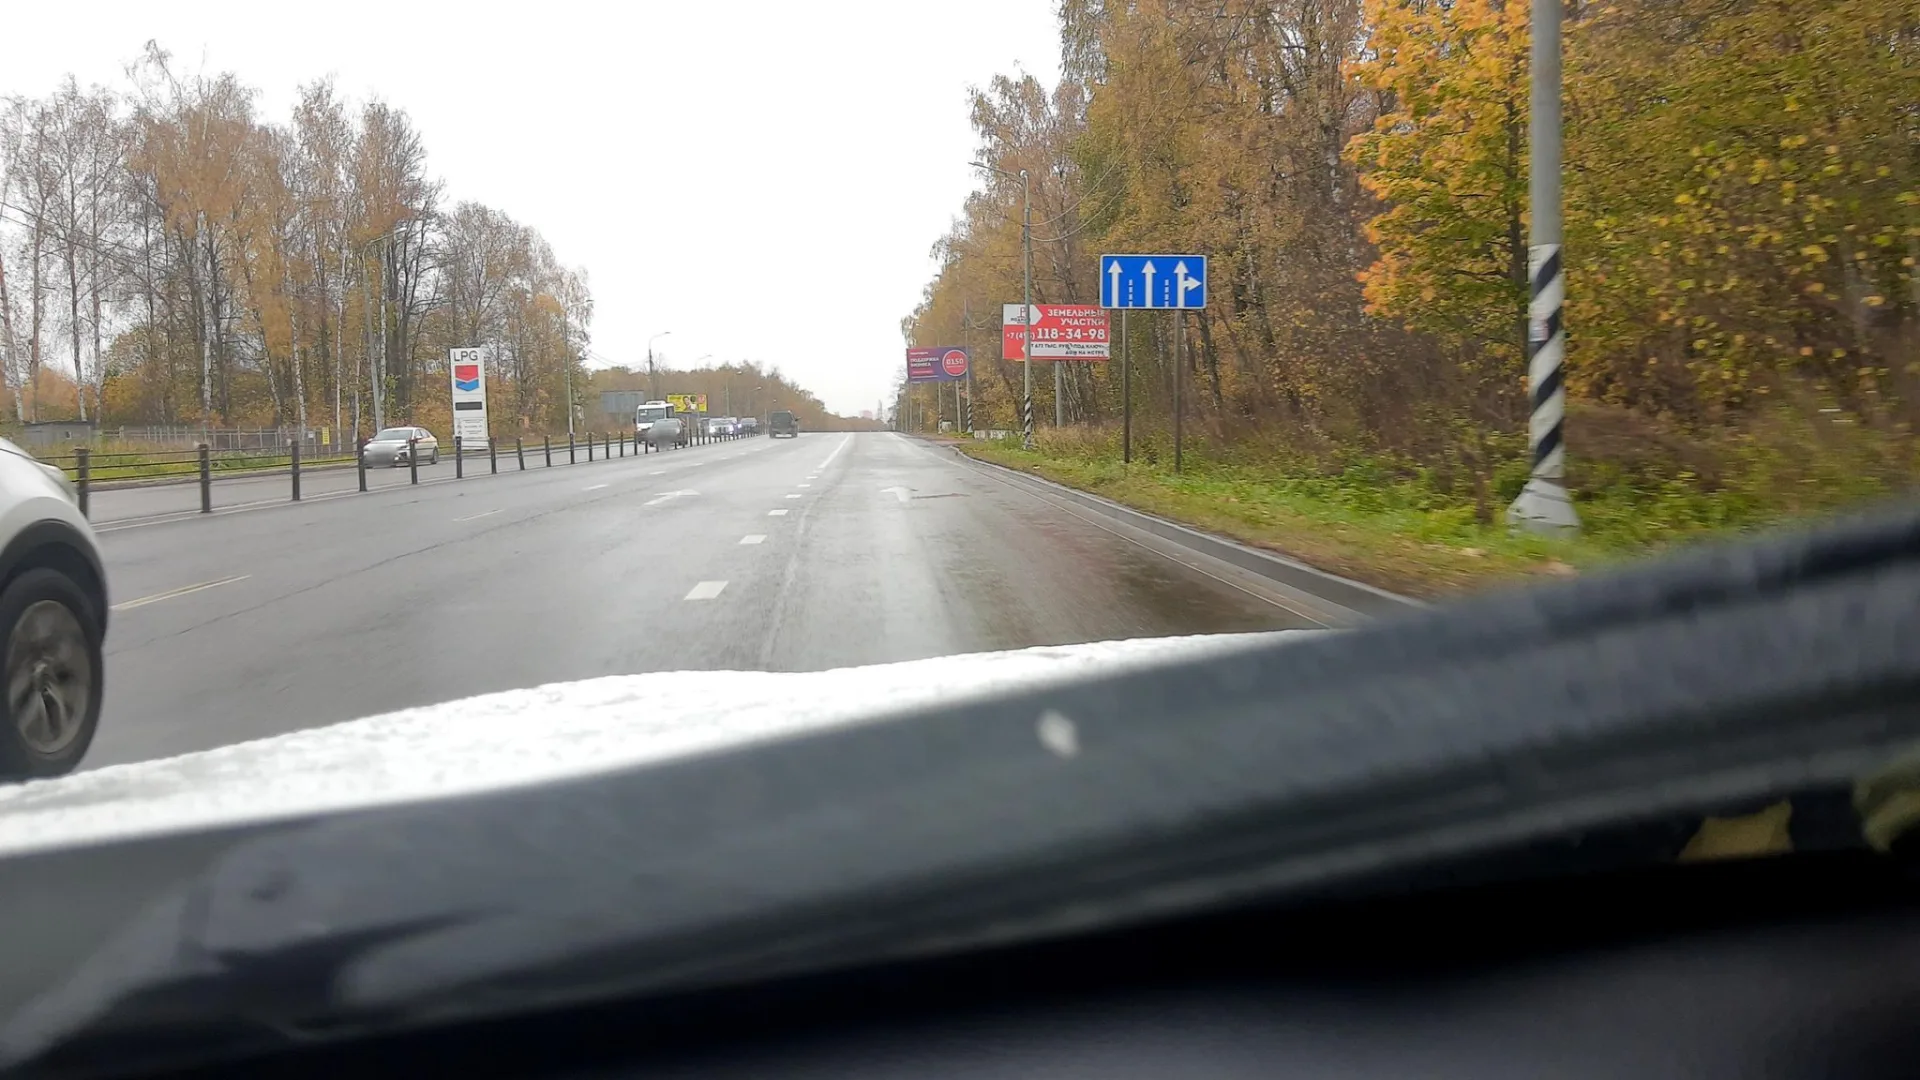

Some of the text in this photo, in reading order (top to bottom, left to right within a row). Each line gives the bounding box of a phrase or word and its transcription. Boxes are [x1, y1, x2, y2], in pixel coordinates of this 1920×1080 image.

[1047, 309, 1105, 317] ЗЕМЕЛЬНЫЕ
[1060, 318, 1105, 326] УЧАСТКИ
[1015, 332, 1036, 340] (4)
[1037, 328, 1106, 339] 118-34-98
[453, 350, 479, 361] LPG
